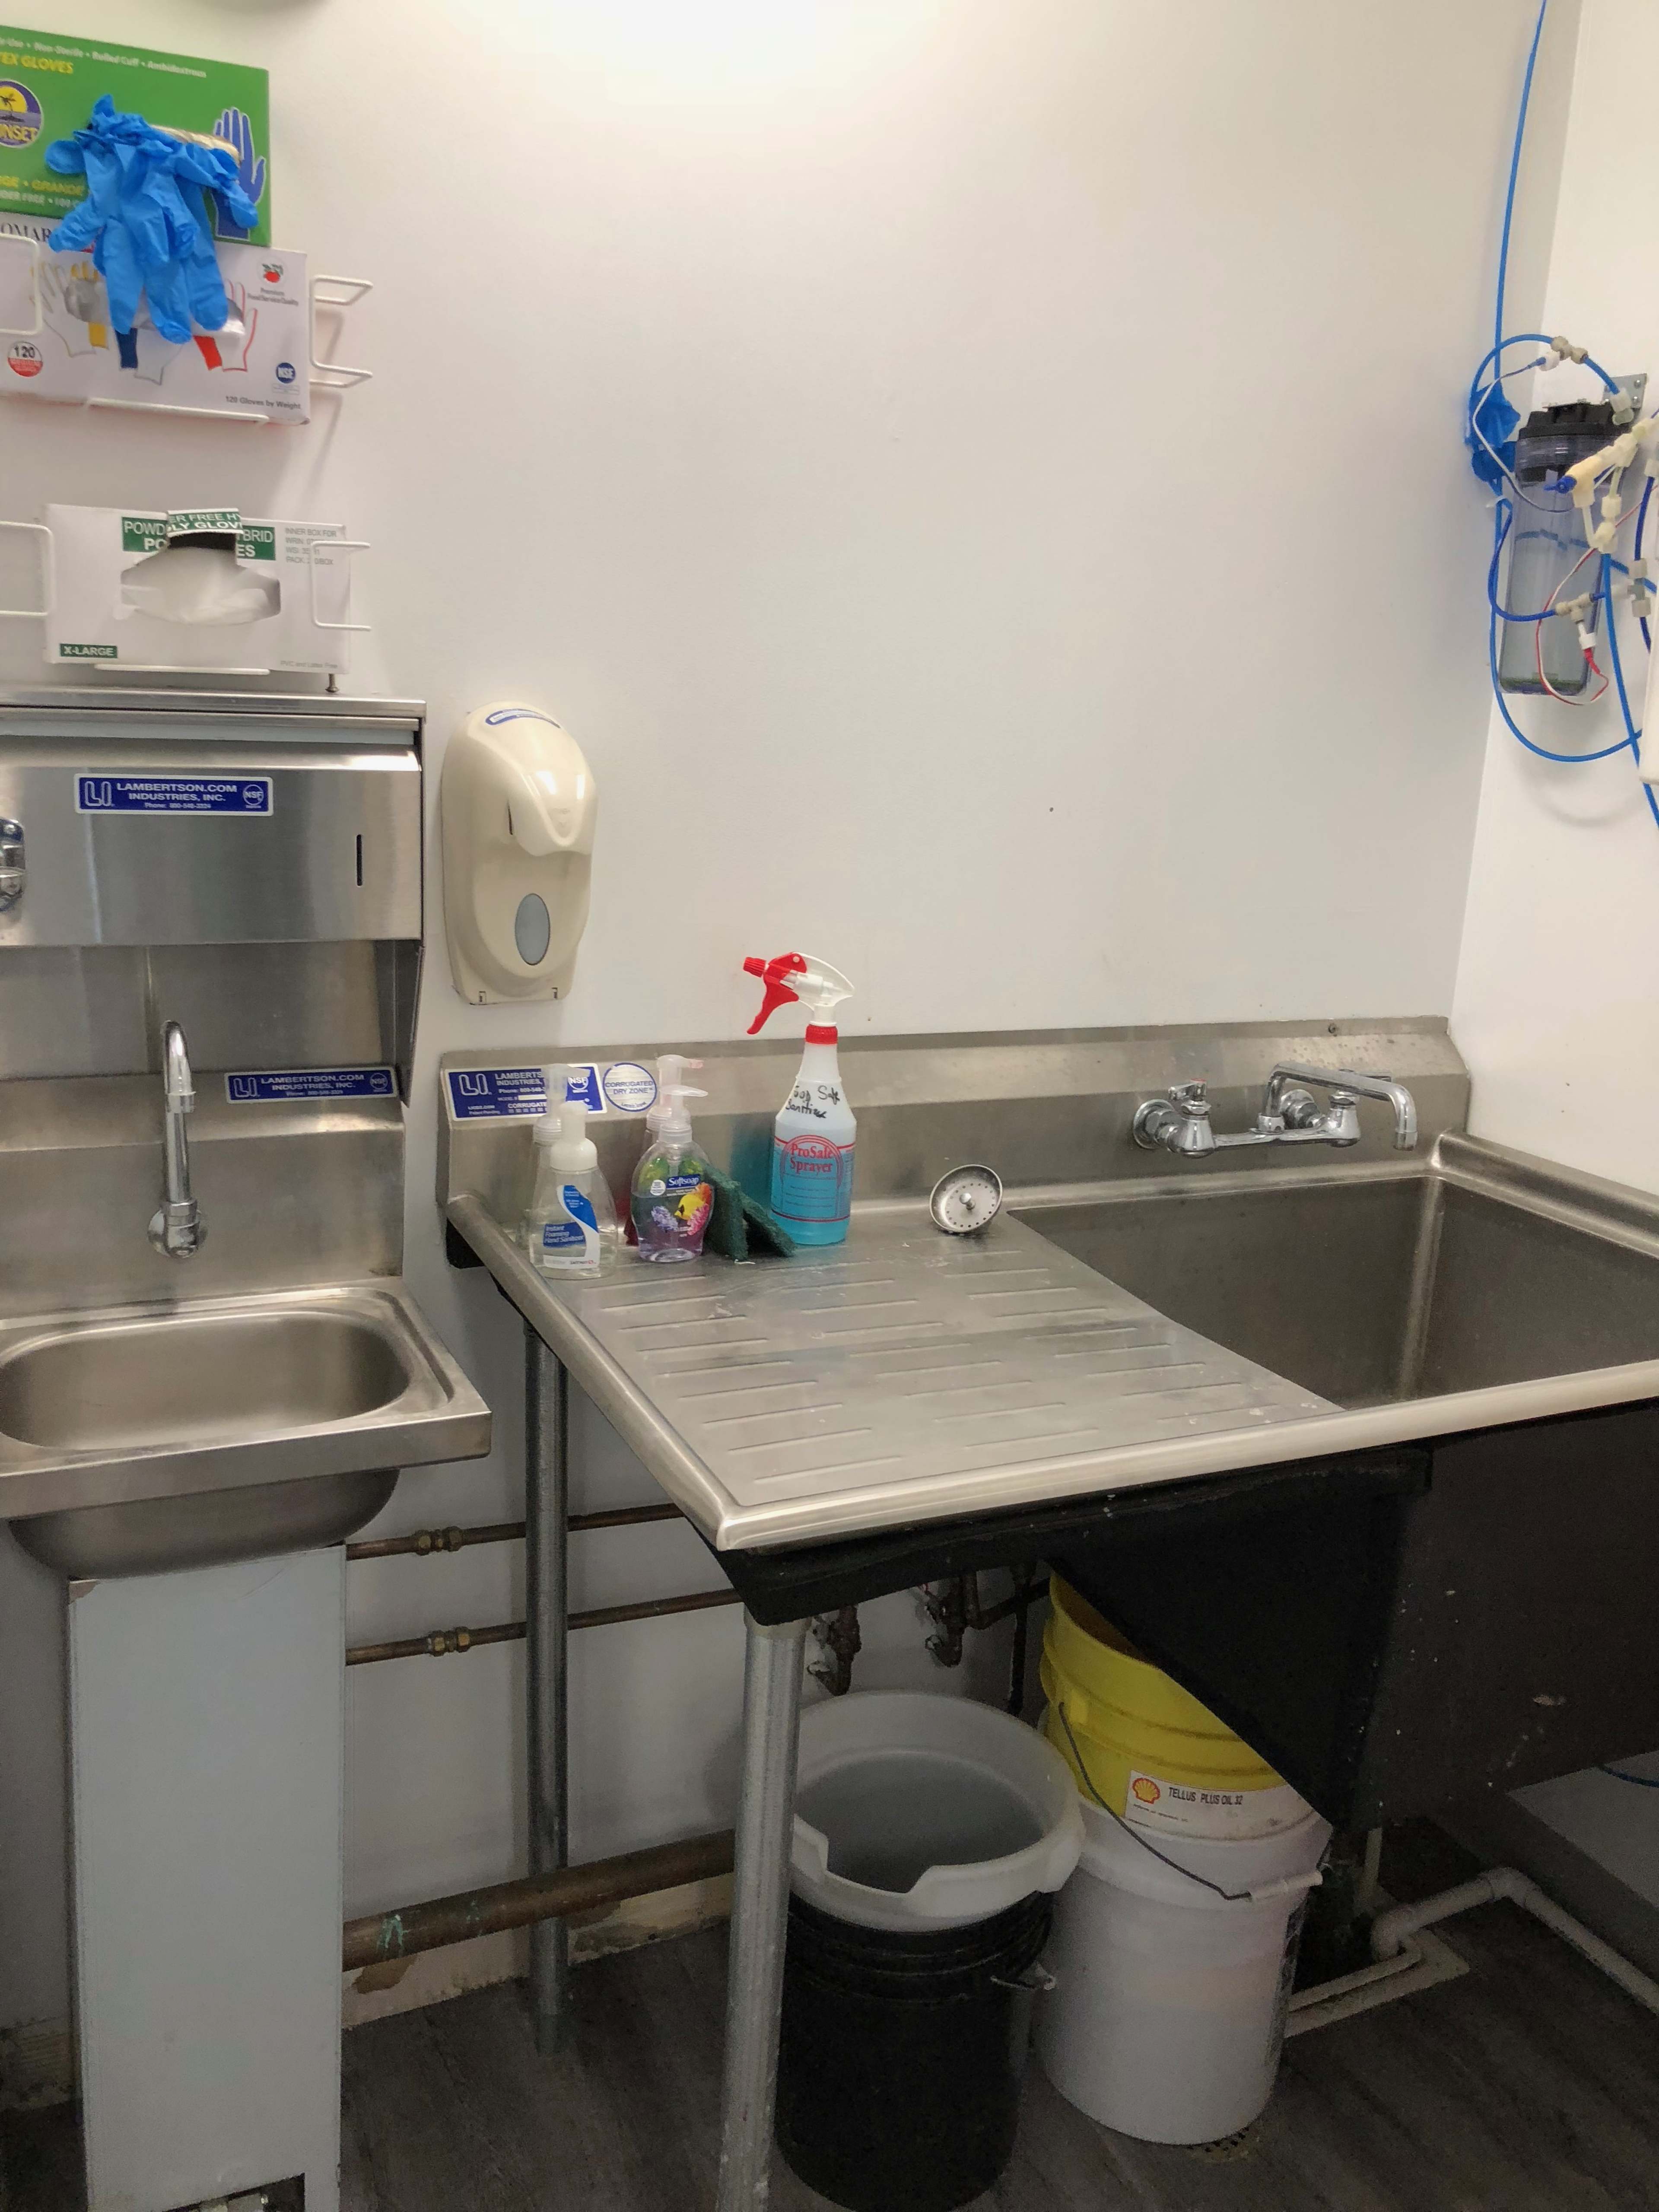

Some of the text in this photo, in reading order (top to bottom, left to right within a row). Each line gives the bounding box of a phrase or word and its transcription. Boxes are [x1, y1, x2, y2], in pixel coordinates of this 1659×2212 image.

[21, 55, 74, 74] GLOVES
[14, 345, 35, 359] 120
[239, 397, 264, 406] Gloves
[276, 400, 301, 410] Weight
[188, 513, 225, 521] FREE
[124, 520, 166, 536] POWD
[285, 527, 306, 535] INNER
[237, 544, 256, 557] ES
[64, 646, 114, 656] X-LARGE
[117, 783, 237, 792] LAMBERTSON.COM
[244, 791, 263, 799] NSF
[129, 793, 200, 801] INDUSTRIES,
[261, 1074, 364, 1084] LAMBERTSON.COM
[817, 1085, 840, 1105] Safe
[791, 1143, 832, 1159] ProSafe
[790, 1157, 833, 1175] Sprayer
[668, 1177, 699, 1186] Softsoap
[1169, 1787, 1243, 1805] TELLUS PLUS OIL 32
